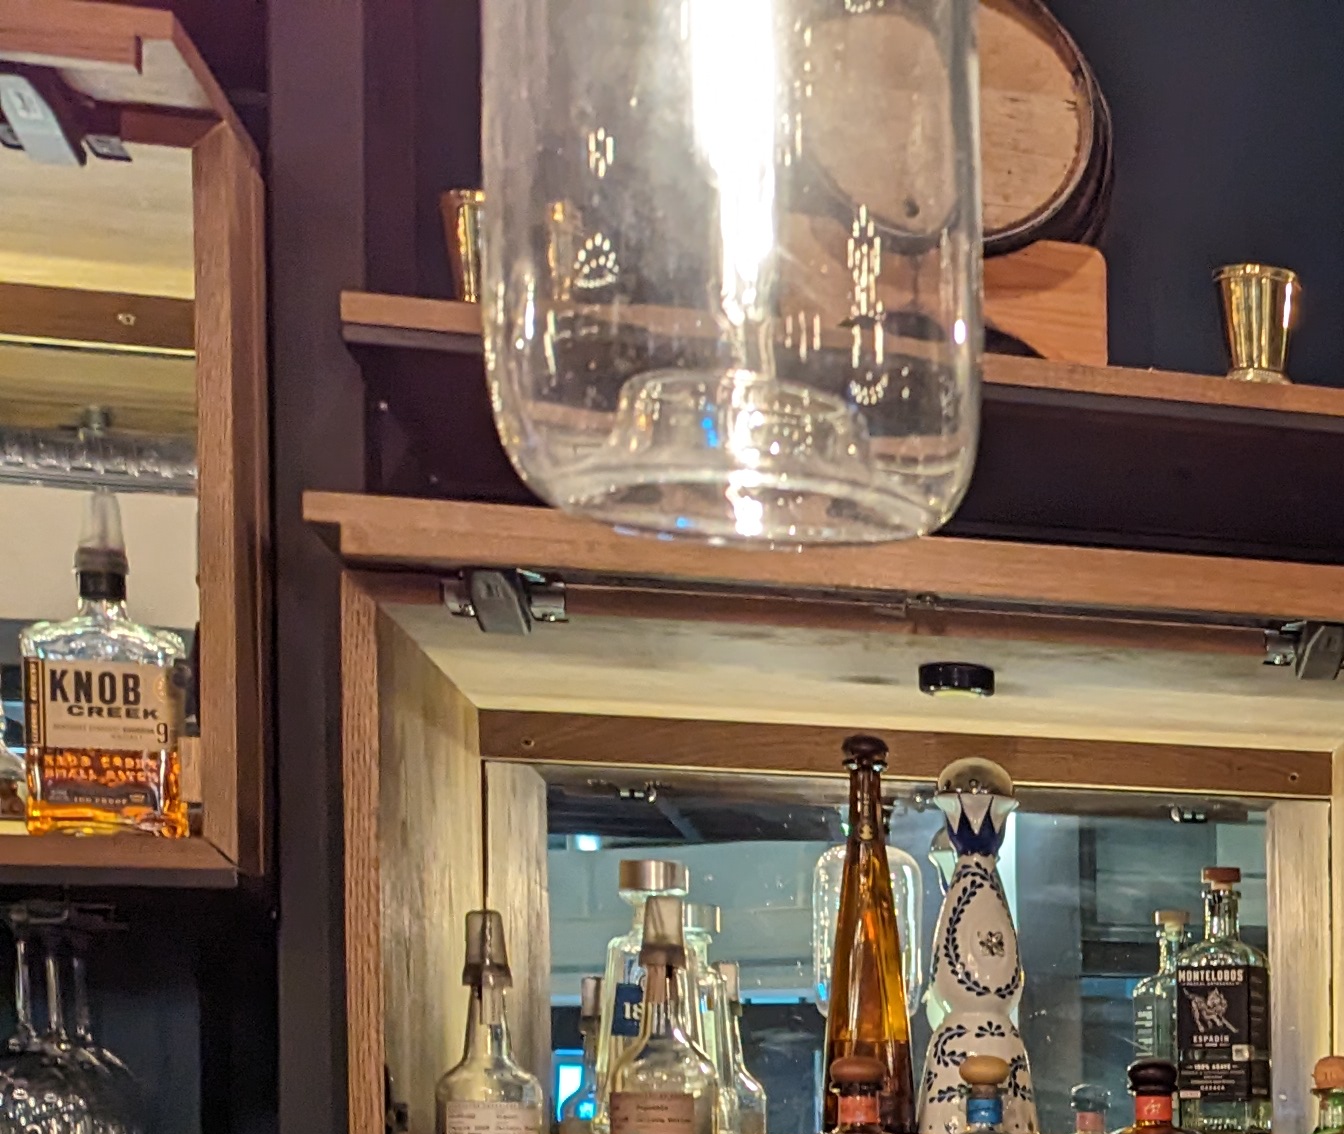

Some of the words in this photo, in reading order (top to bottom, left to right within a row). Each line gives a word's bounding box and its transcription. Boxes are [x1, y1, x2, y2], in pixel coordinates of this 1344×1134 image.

[50, 669, 141, 705] KNOB
[67, 705, 159, 720] CREEK
[156, 723, 169, 744] 9
[1178, 969, 1244, 982] MONTELOBOS
[624, 1001, 642, 1020] 18
